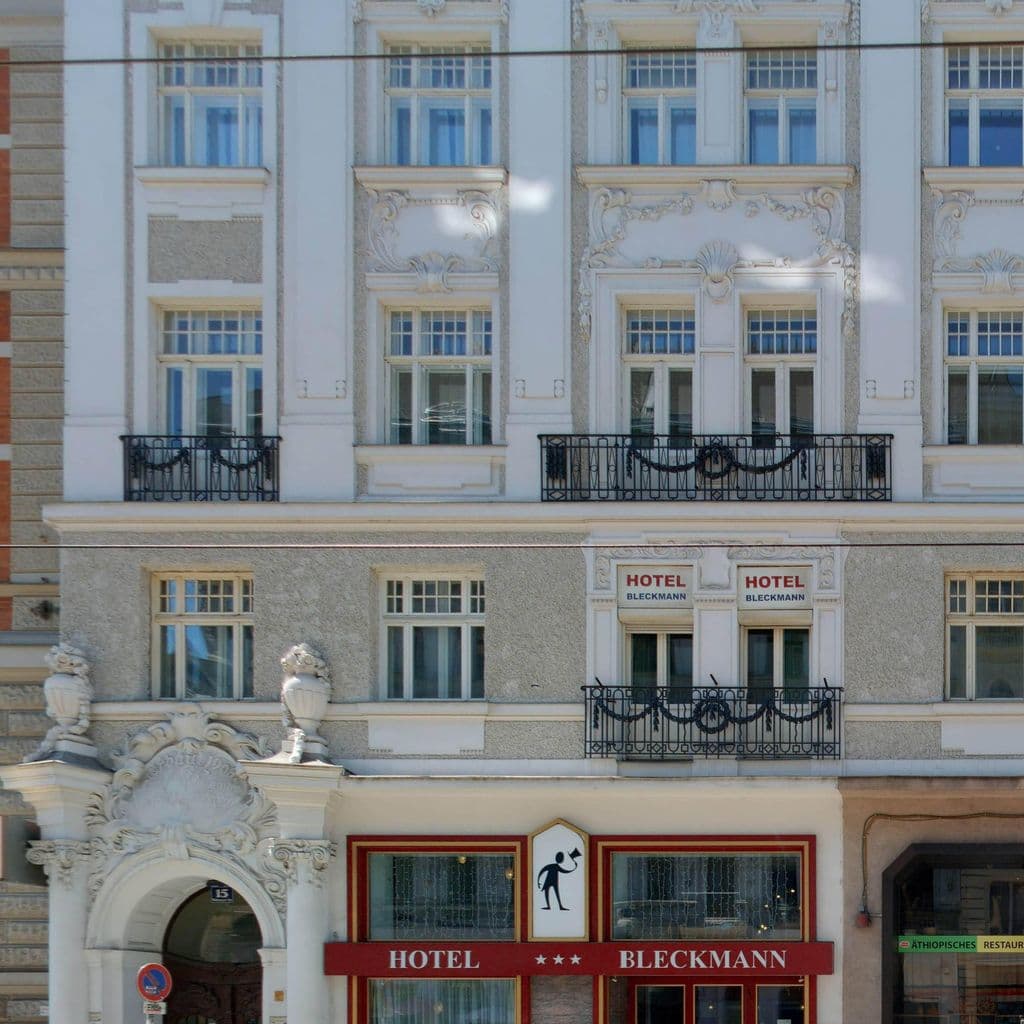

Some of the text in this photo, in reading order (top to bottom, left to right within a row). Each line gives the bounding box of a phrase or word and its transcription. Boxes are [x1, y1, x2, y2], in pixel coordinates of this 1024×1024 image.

[626, 574, 687, 588] HOTEL
[745, 576, 805, 588] HOTEL
[626, 592, 687, 601] BLECKMANN
[745, 593, 805, 602] BLECKMANN
[215, 888, 229, 898] 15
[911, 939, 976, 949] ÄTHIOPISCHES
[389, 950, 787, 969] HOTEL BLECKMANN
